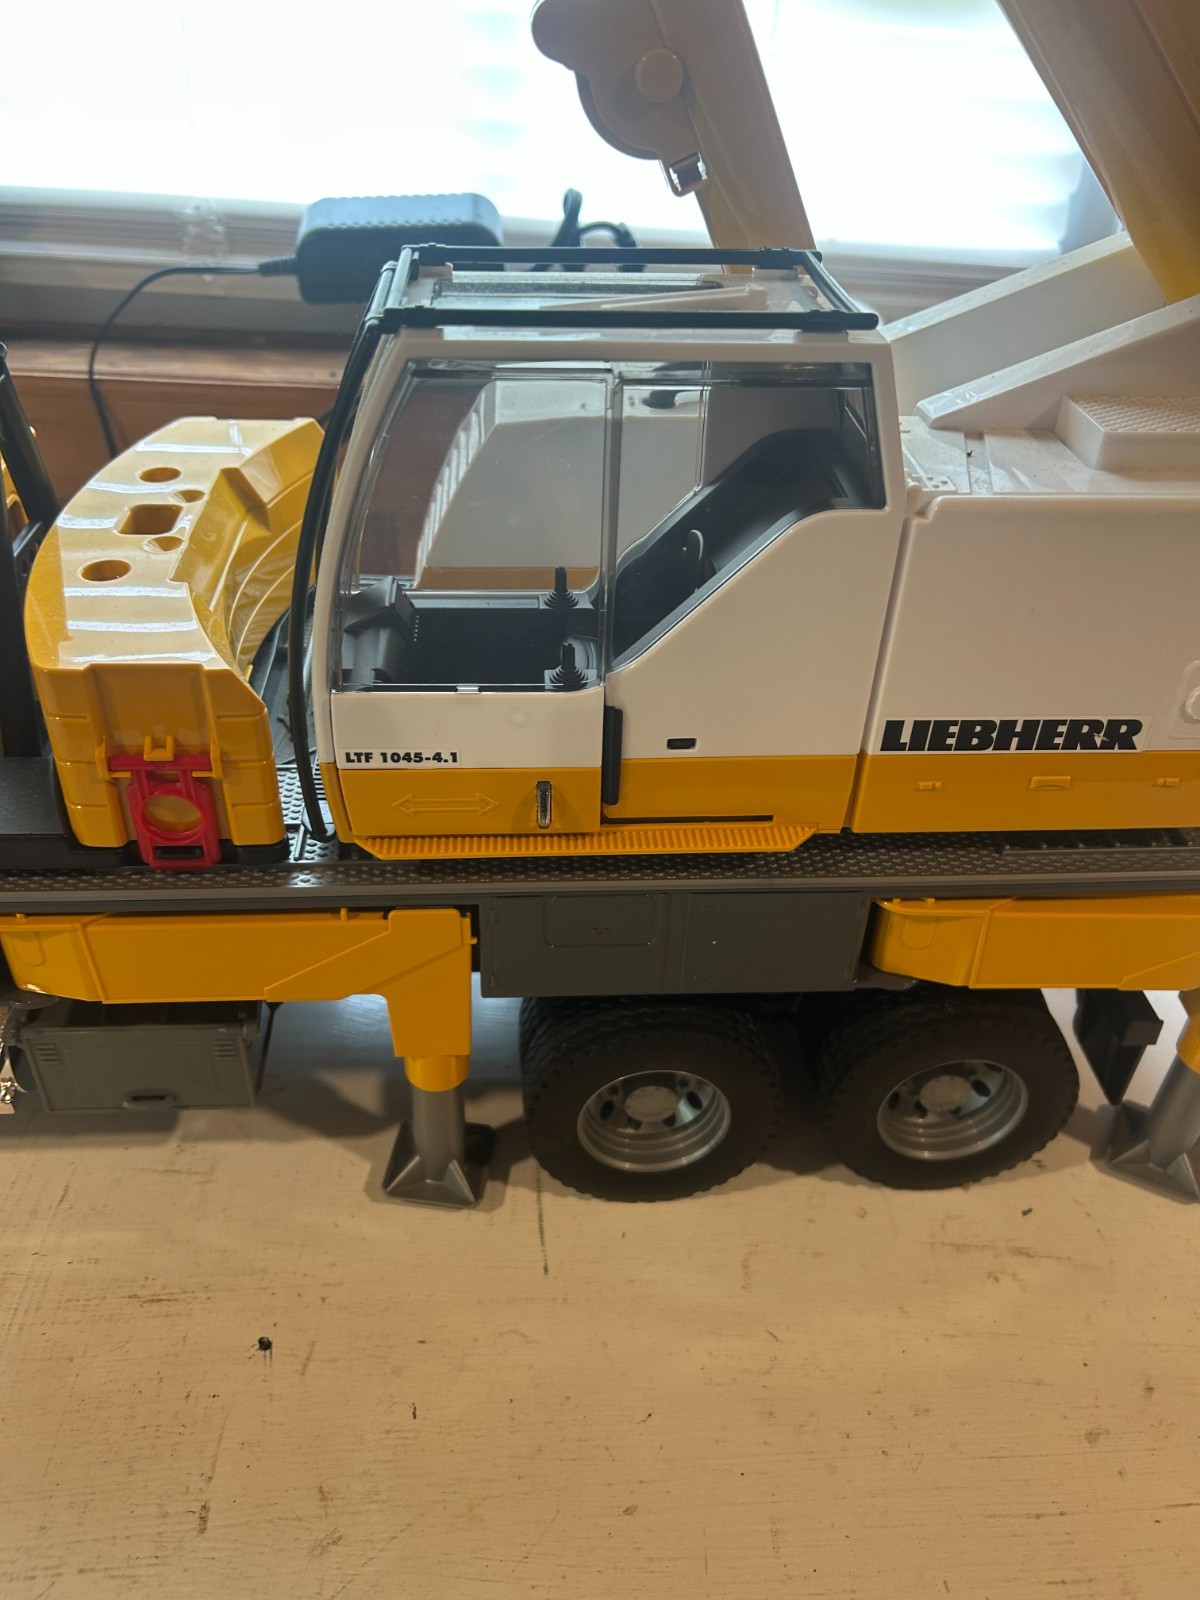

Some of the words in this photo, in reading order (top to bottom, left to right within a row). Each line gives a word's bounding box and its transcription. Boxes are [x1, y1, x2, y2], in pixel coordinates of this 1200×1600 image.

[880, 719, 1143, 751] LIEBHERR
[345, 751, 373, 763] LTF
[379, 751, 458, 763] 1045-4.1
